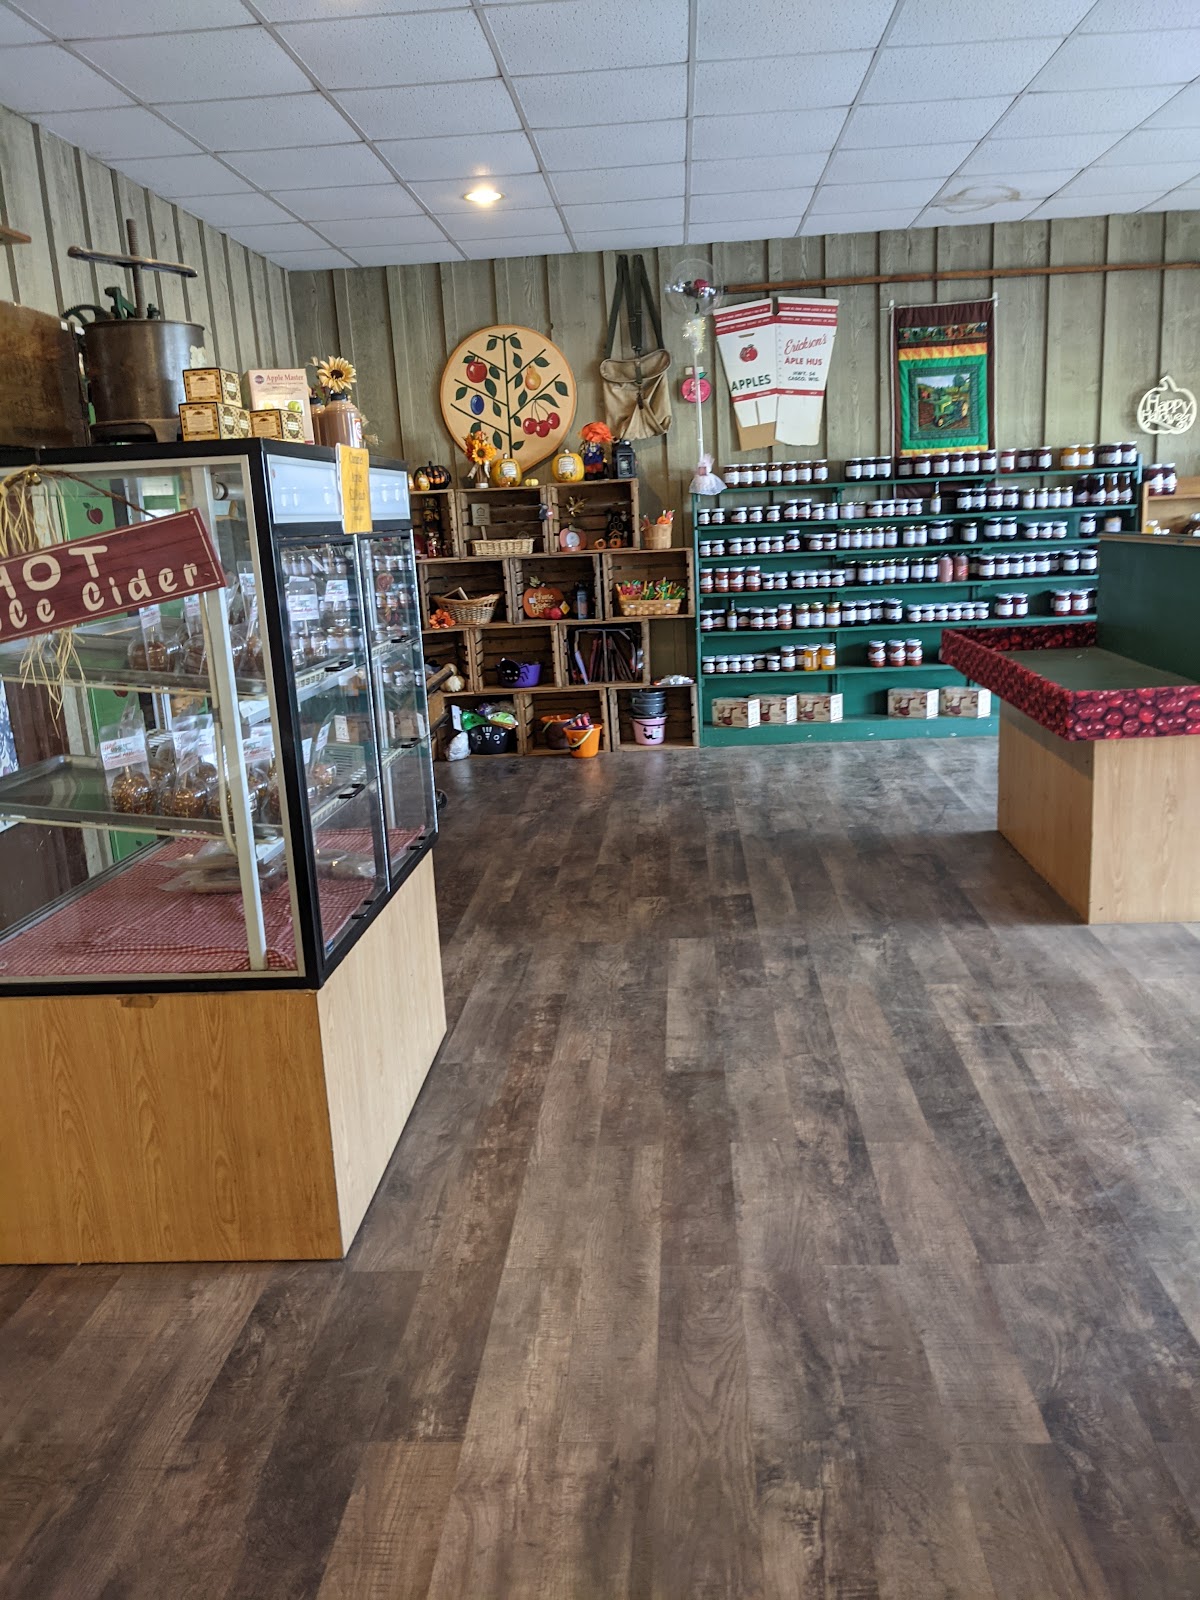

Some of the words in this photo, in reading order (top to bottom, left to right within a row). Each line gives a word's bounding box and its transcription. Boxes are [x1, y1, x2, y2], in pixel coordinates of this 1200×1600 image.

[784, 333, 828, 355] Erickson's
[784, 357, 804, 365] APLE
[806, 358, 823, 366] HUS
[266, 374, 284, 382] Apple
[731, 374, 772, 392] APPLES
[1145, 393, 1194, 419] Happy
